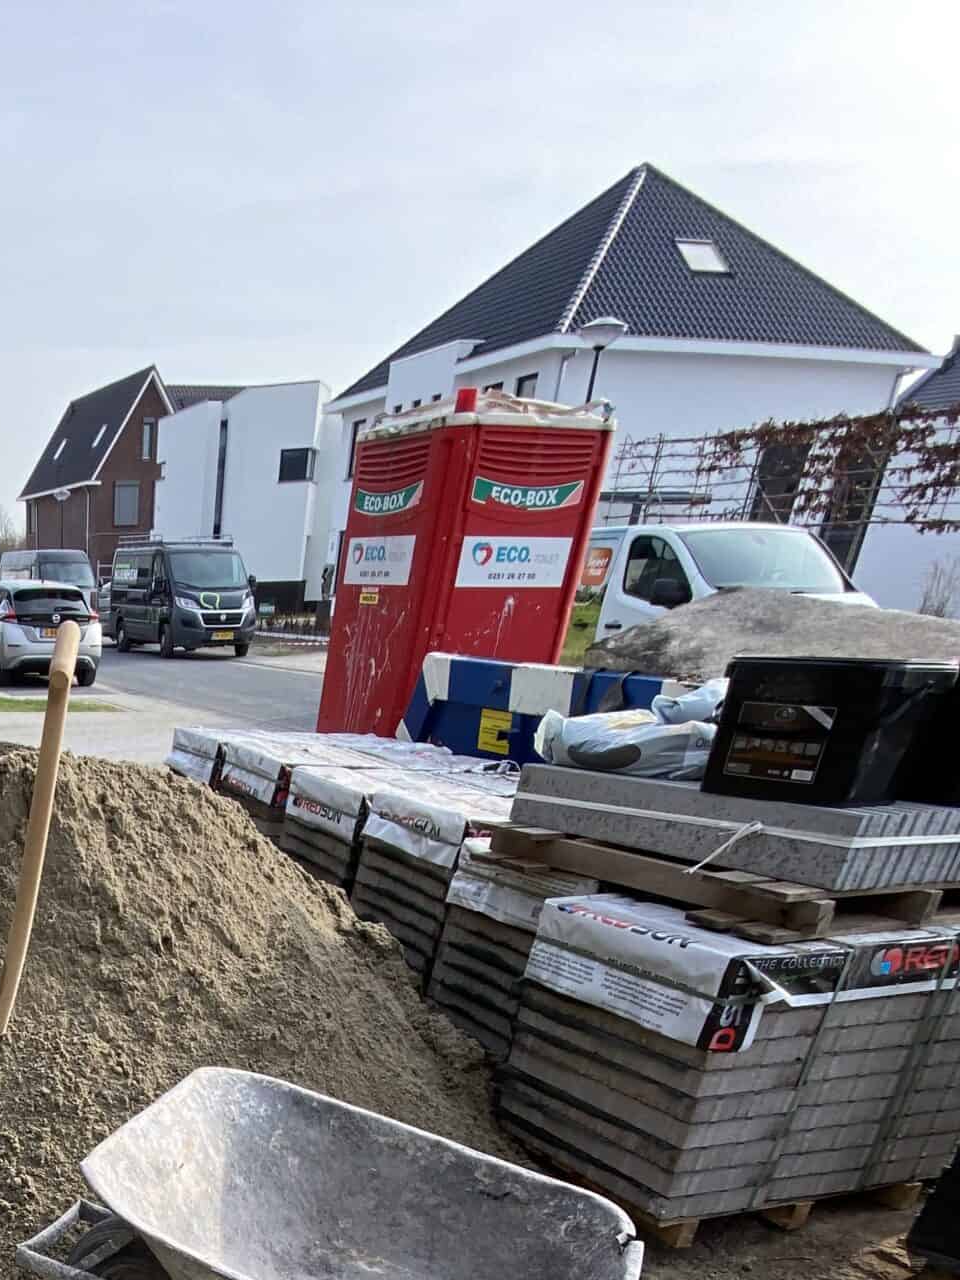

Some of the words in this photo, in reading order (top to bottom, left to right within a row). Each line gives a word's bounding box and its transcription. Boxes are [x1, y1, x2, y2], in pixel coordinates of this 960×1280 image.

[363, 492, 405, 511] ECO-BOX
[491, 486, 560, 506] ECO-BOX
[754, 959, 778, 970] THE
